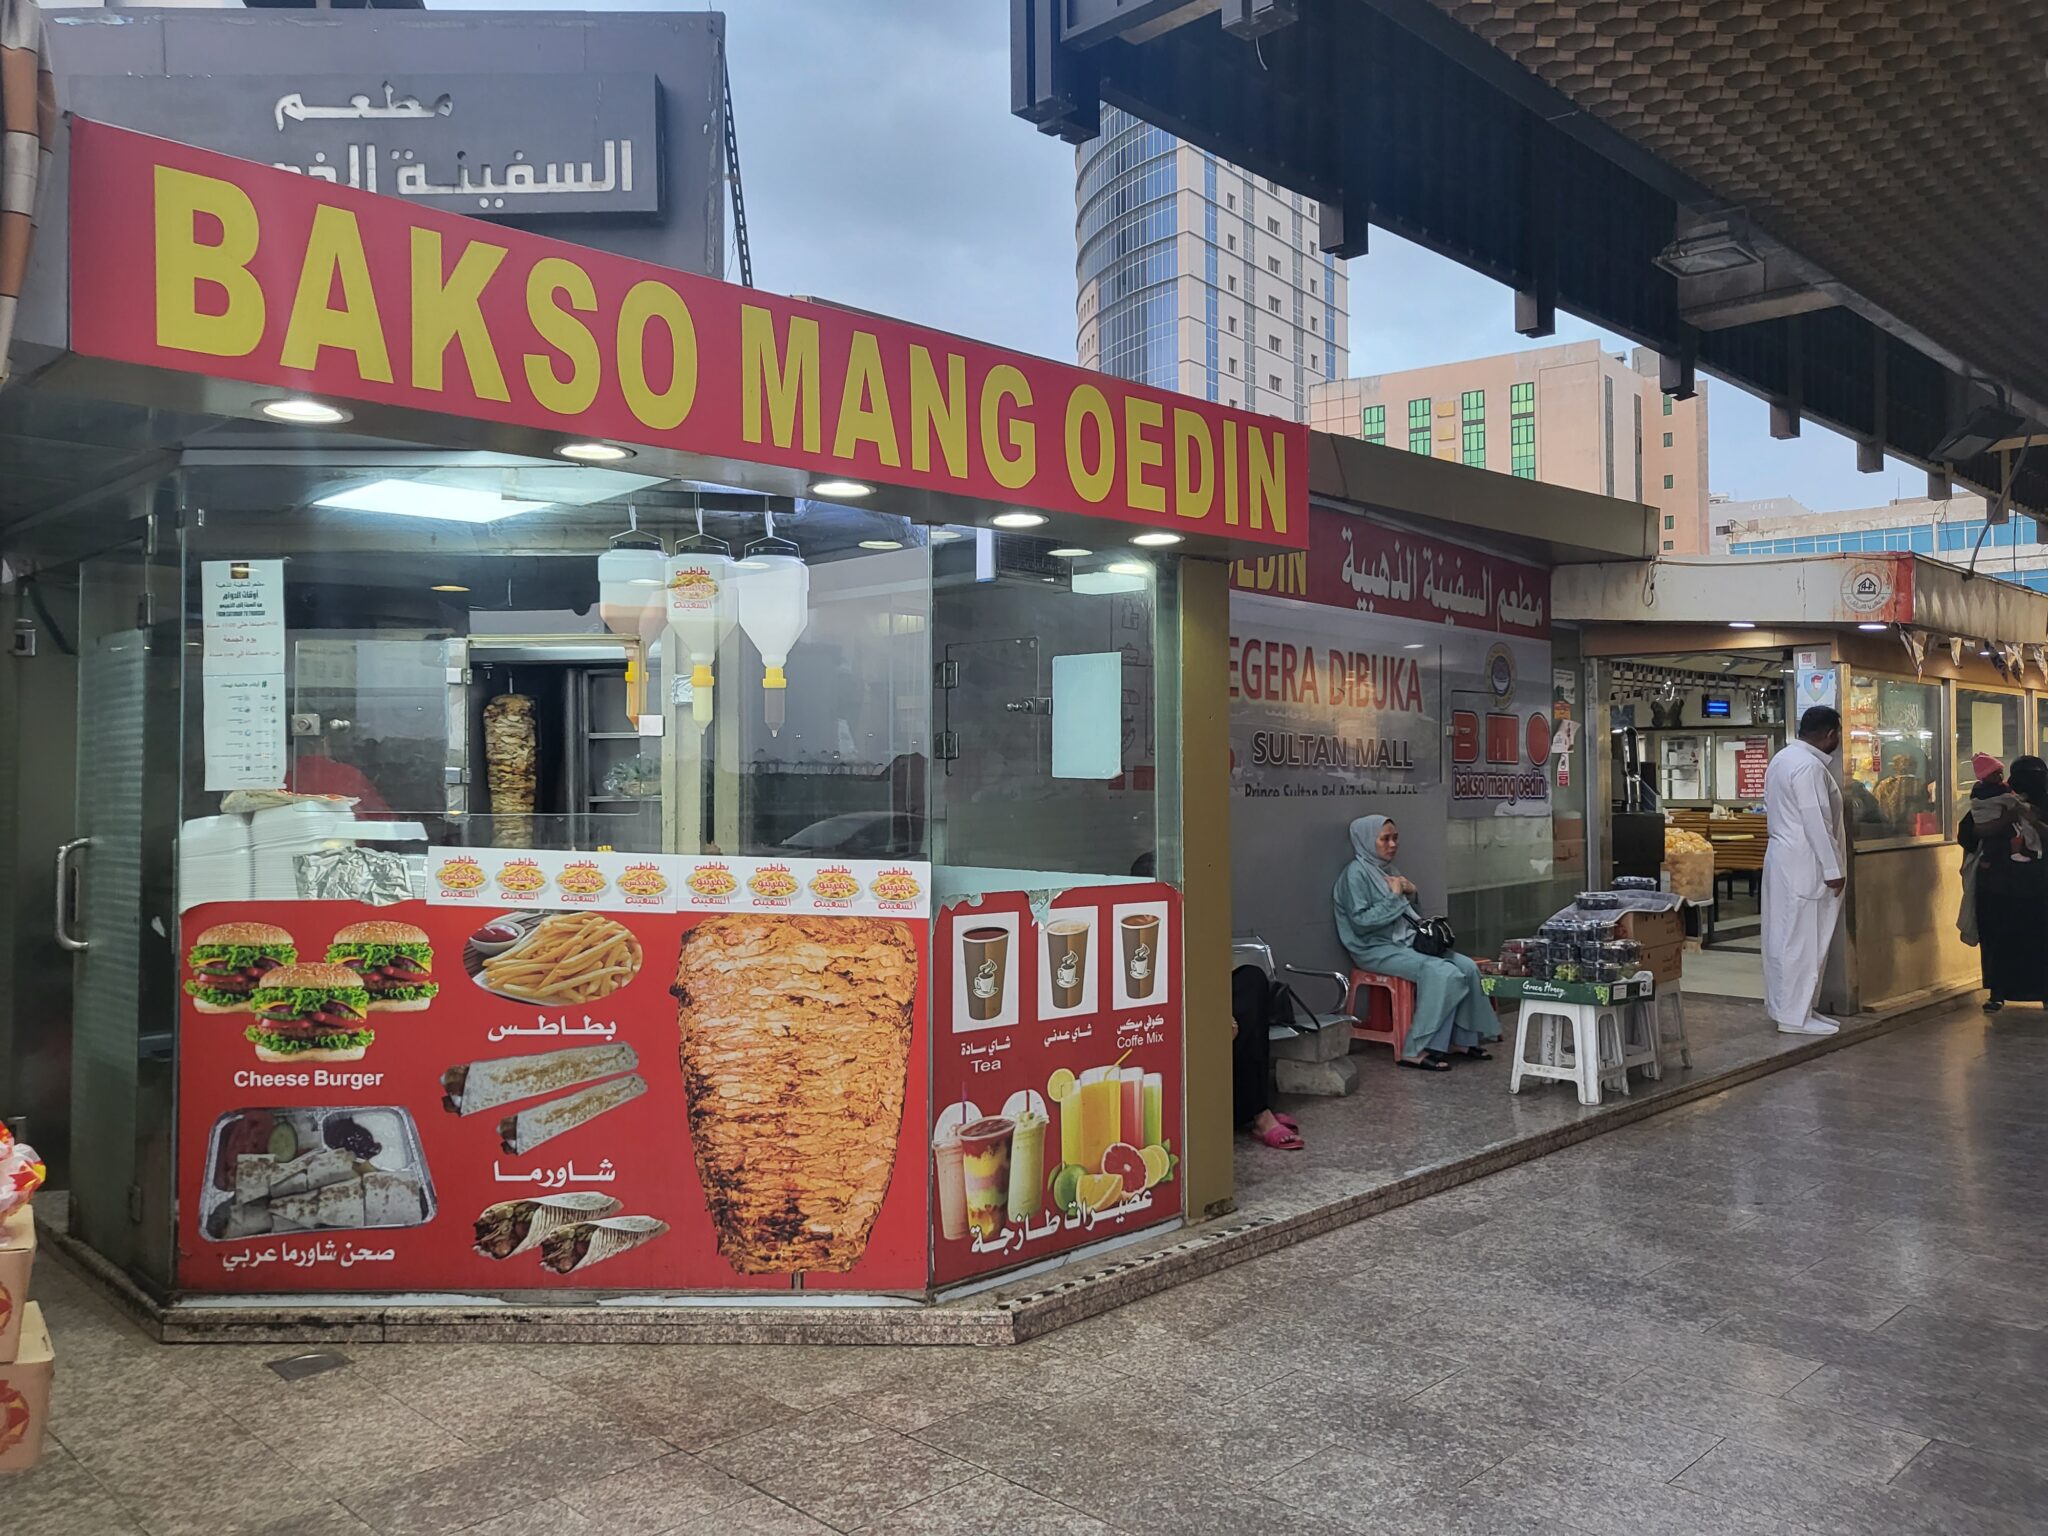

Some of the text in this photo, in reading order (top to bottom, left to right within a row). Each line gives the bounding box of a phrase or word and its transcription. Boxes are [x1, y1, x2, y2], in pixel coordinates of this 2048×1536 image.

[274, 81, 453, 131] مطعم
[391, 139, 633, 209] السفينة
[155, 166, 1286, 532] BAKSO MANG OEDIN
[675, 566, 710, 576] بطاطس
[1341, 527, 1543, 633] مطعم السفينة الذهبية
[1328, 649, 1423, 713] DIBUKA
[1253, 730, 1414, 769] SULTAN MALL
[1453, 766, 1546, 805] bakso mang oedin
[444, 855, 478, 865] بطاطس
[504, 858, 538, 867] بطاطس
[564, 859, 599, 869] بطاطس
[625, 862, 659, 871] بطاطس
[694, 861, 729, 872] بطاطس
[756, 863, 791, 873] بطاطس
[817, 865, 851, 875] بطاطس
[878, 867, 913, 877] بطاطس
[1522, 980, 1565, 998] Green Honey
[487, 1014, 617, 1042] بطاطس
[1117, 1014, 1165, 1034] كوفي ميكس
[961, 1035, 1011, 1056] شاي سادة
[1044, 1023, 1092, 1048] شاي عدني
[1117, 1032, 1164, 1050] Coffe Mix
[971, 1058, 1002, 1073] Tea
[233, 1069, 384, 1089] Cheese Burger
[493, 1158, 616, 1188] شاورما
[971, 1190, 1153, 1256] عصيرات طازجة
[223, 1240, 396, 1271] صحن شاورما عربي
